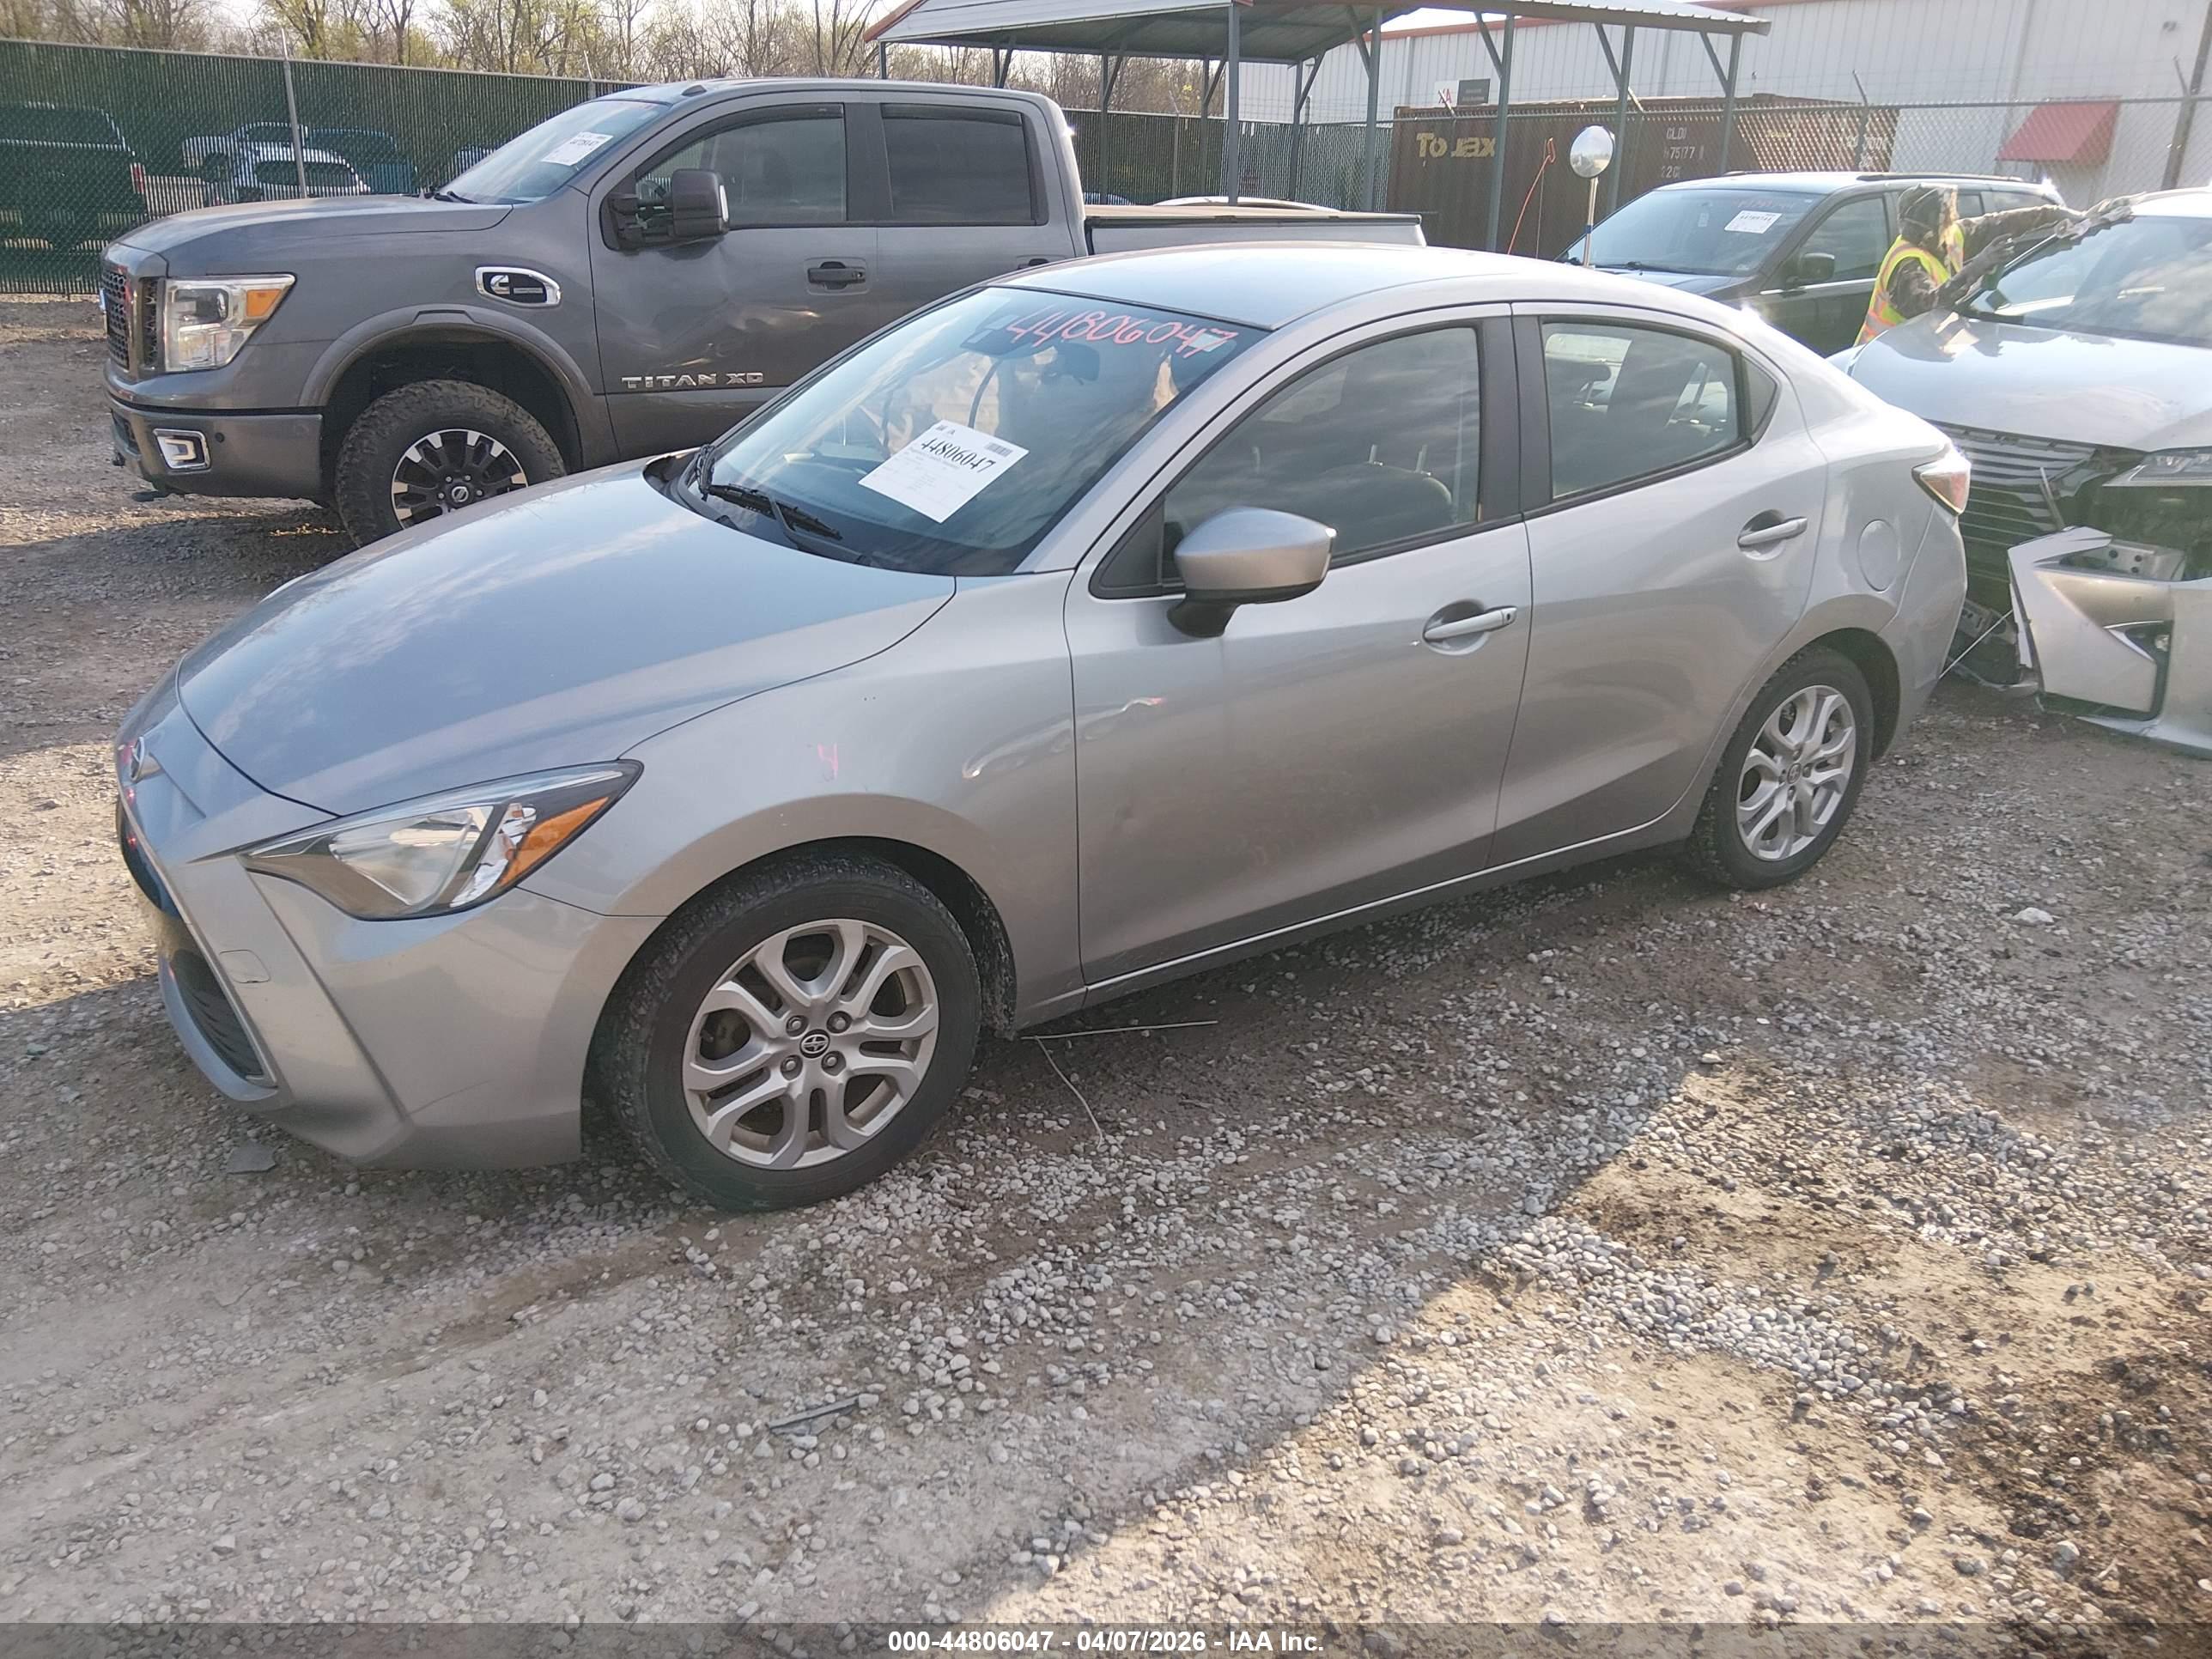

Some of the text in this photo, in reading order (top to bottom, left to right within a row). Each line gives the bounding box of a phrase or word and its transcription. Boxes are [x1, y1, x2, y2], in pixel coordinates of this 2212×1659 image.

[1006, 306, 1238, 359] 44806047
[622, 372, 763, 389] TITAN XD
[921, 438, 997, 473] 44806047
